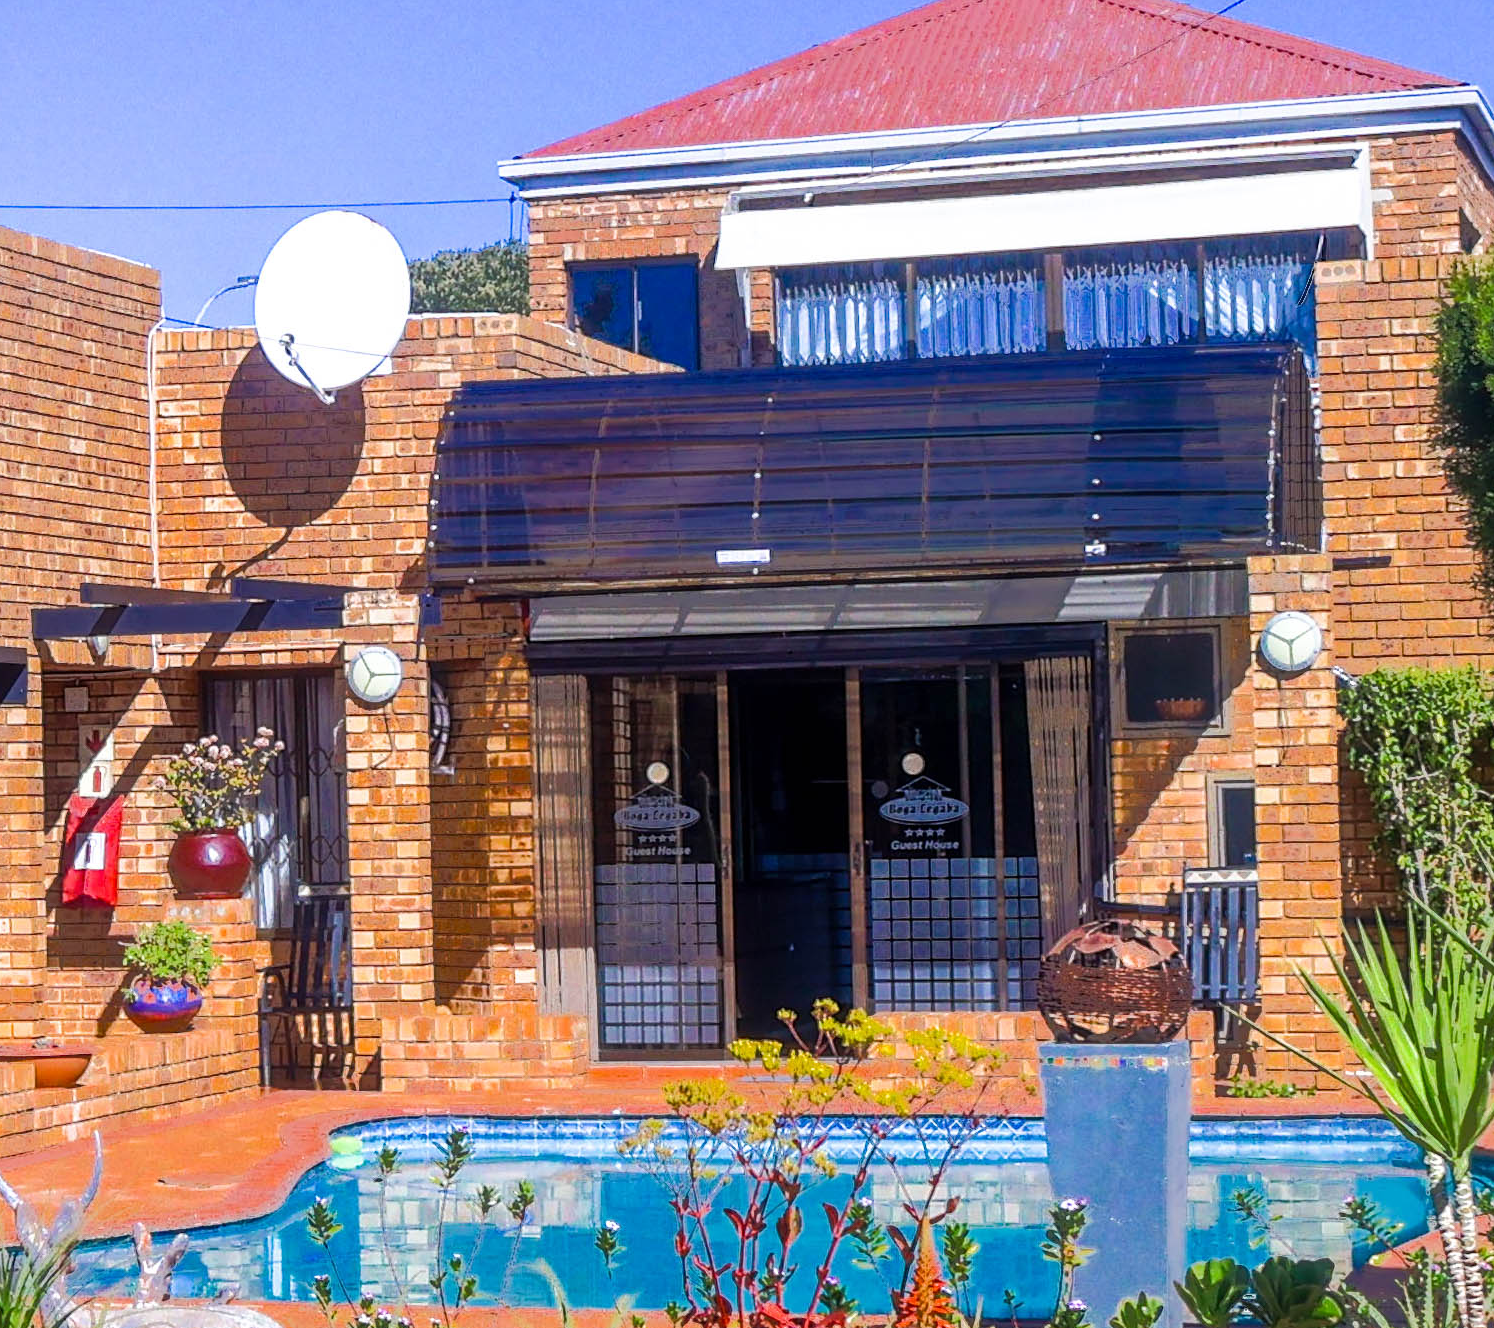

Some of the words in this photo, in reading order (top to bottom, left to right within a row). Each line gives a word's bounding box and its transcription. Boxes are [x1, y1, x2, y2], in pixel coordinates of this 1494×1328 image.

[891, 840, 922, 850] Guest
[925, 840, 959, 850] House
[627, 846, 656, 856] Guest
[657, 846, 691, 856] House
